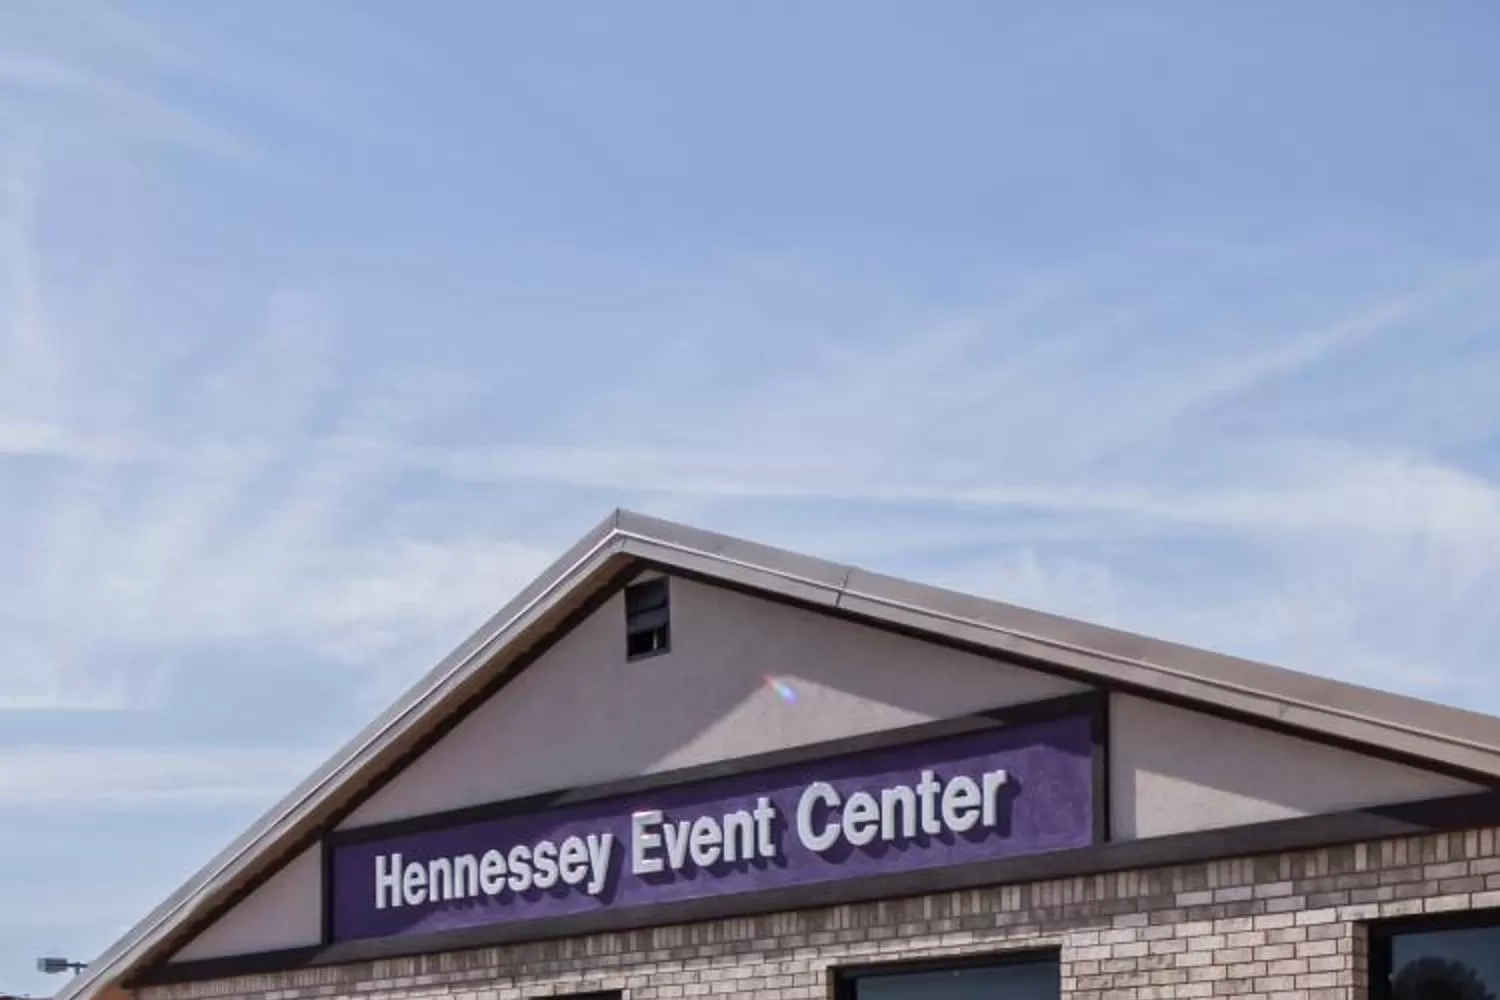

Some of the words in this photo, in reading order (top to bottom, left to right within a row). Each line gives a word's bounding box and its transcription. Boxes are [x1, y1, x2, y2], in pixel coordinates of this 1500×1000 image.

[375, 833, 613, 909] Hennessey
[631, 797, 775, 876] Event
[797, 769, 1007, 852] Center
